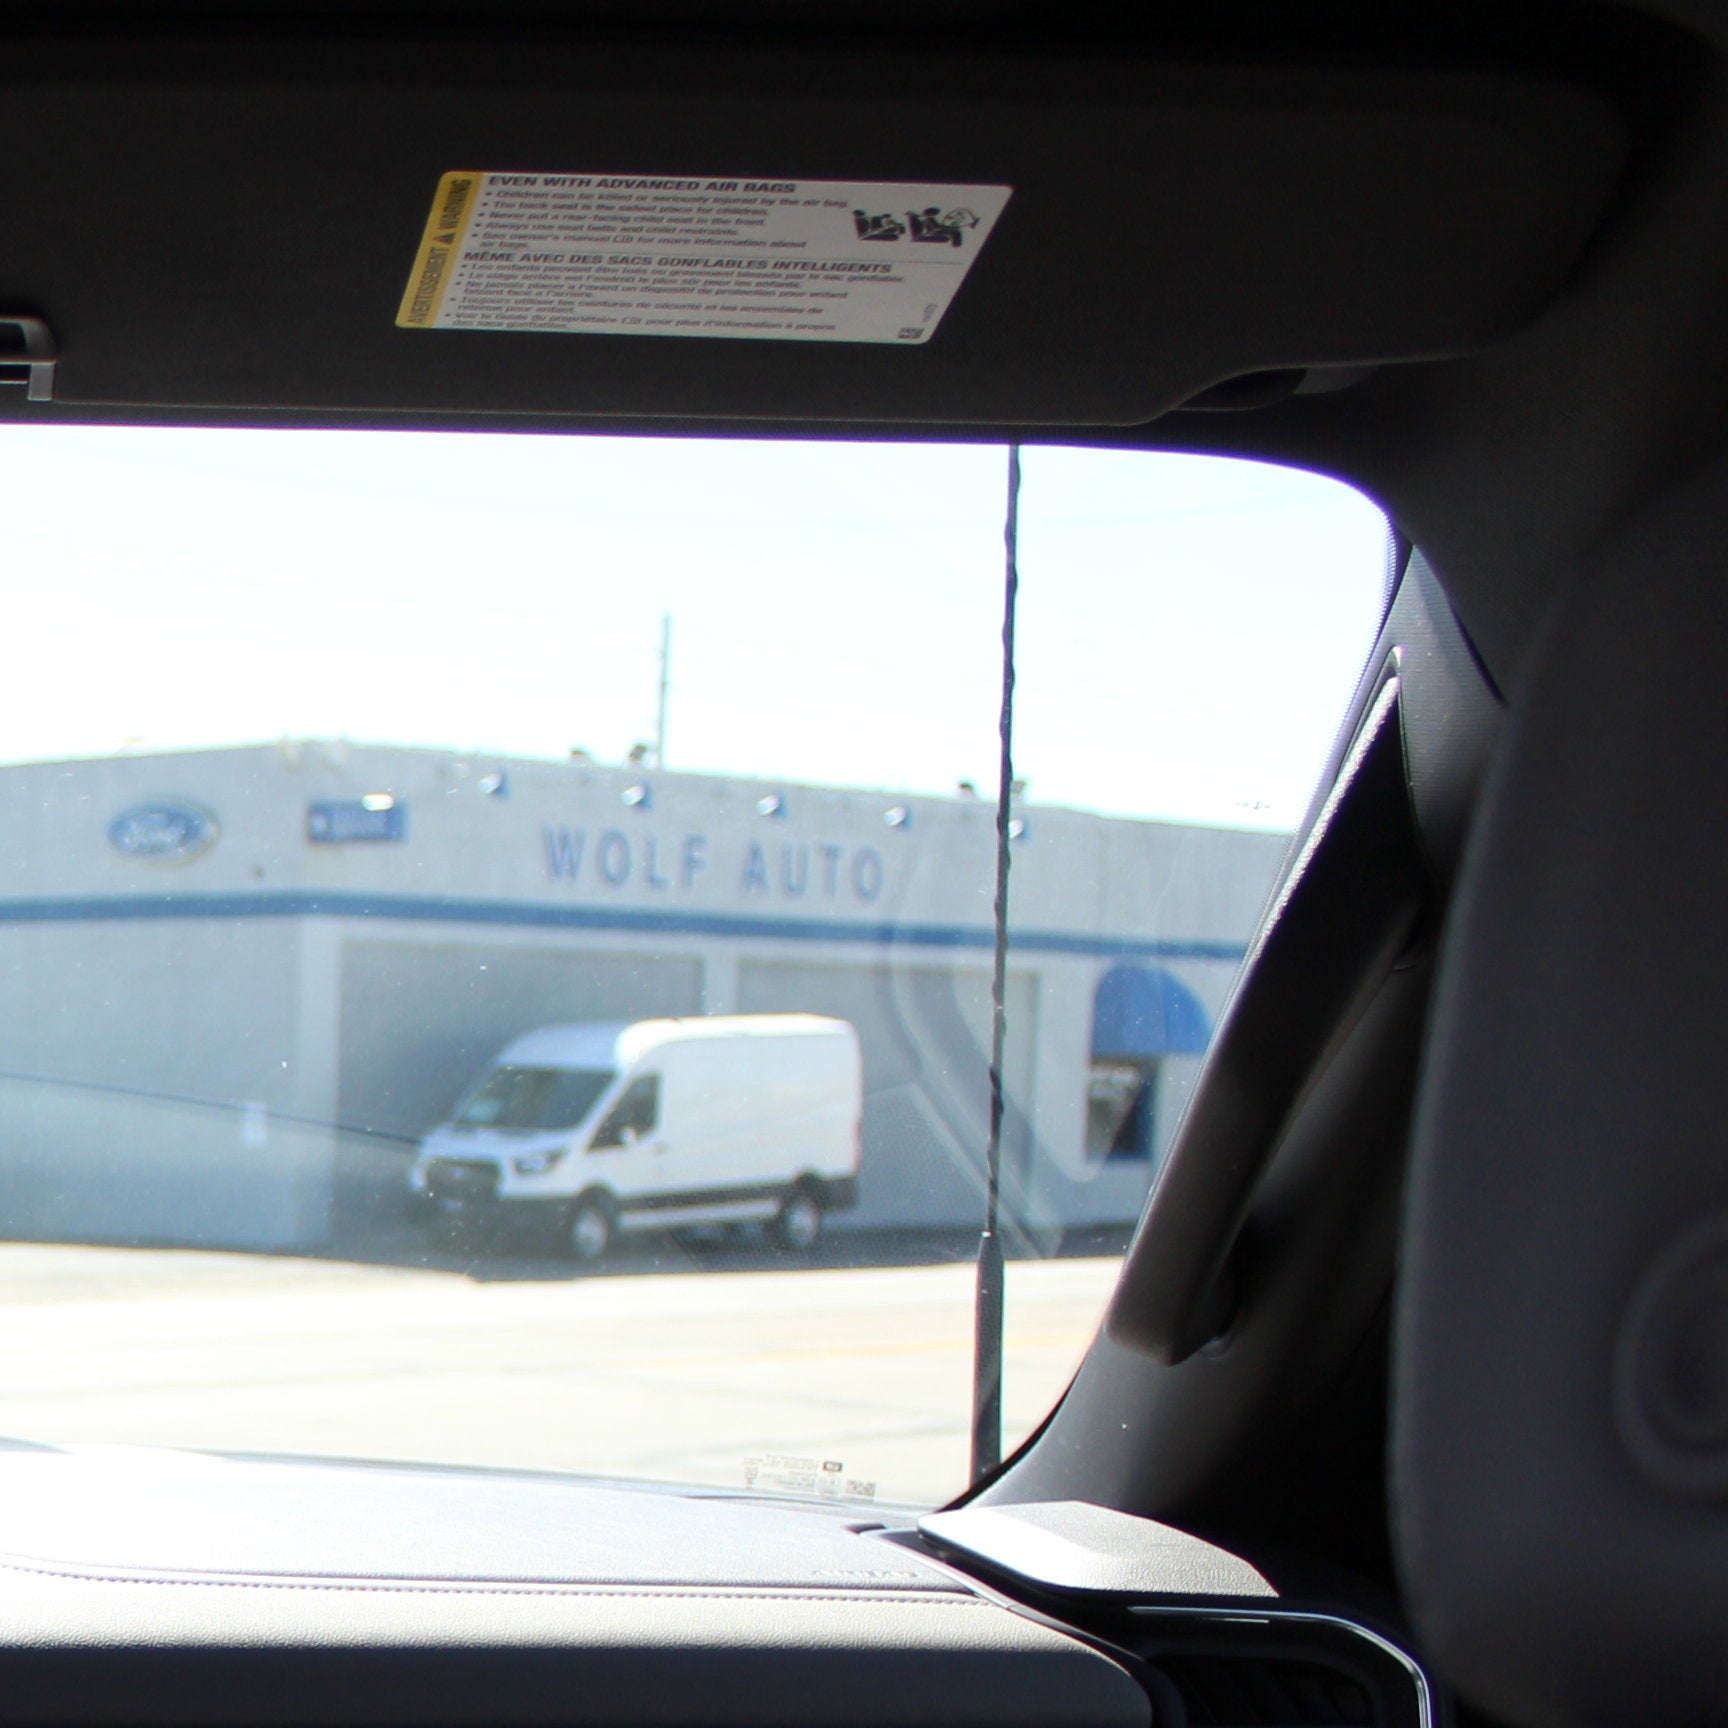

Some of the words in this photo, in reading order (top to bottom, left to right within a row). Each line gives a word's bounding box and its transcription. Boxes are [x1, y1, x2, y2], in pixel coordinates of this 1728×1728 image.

[440, 179, 470, 228] WARNING
[488, 175, 537, 186] EVEN
[542, 177, 591, 187] WITH
[596, 178, 700, 190] ADVANCED
[705, 181, 738, 191] AIR
[742, 181, 796, 193] BAGS
[409, 247, 447, 323] AVERTISSEMENT
[520, 253, 564, 263] AVEC
[569, 254, 602, 264] DES
[607, 255, 653, 265] SACS
[657, 257, 768, 269] GONFLABLES
[772, 260, 892, 272] INTELLIGENTS
[542, 824, 712, 891] WOLF
[739, 837, 886, 906] AUTO
